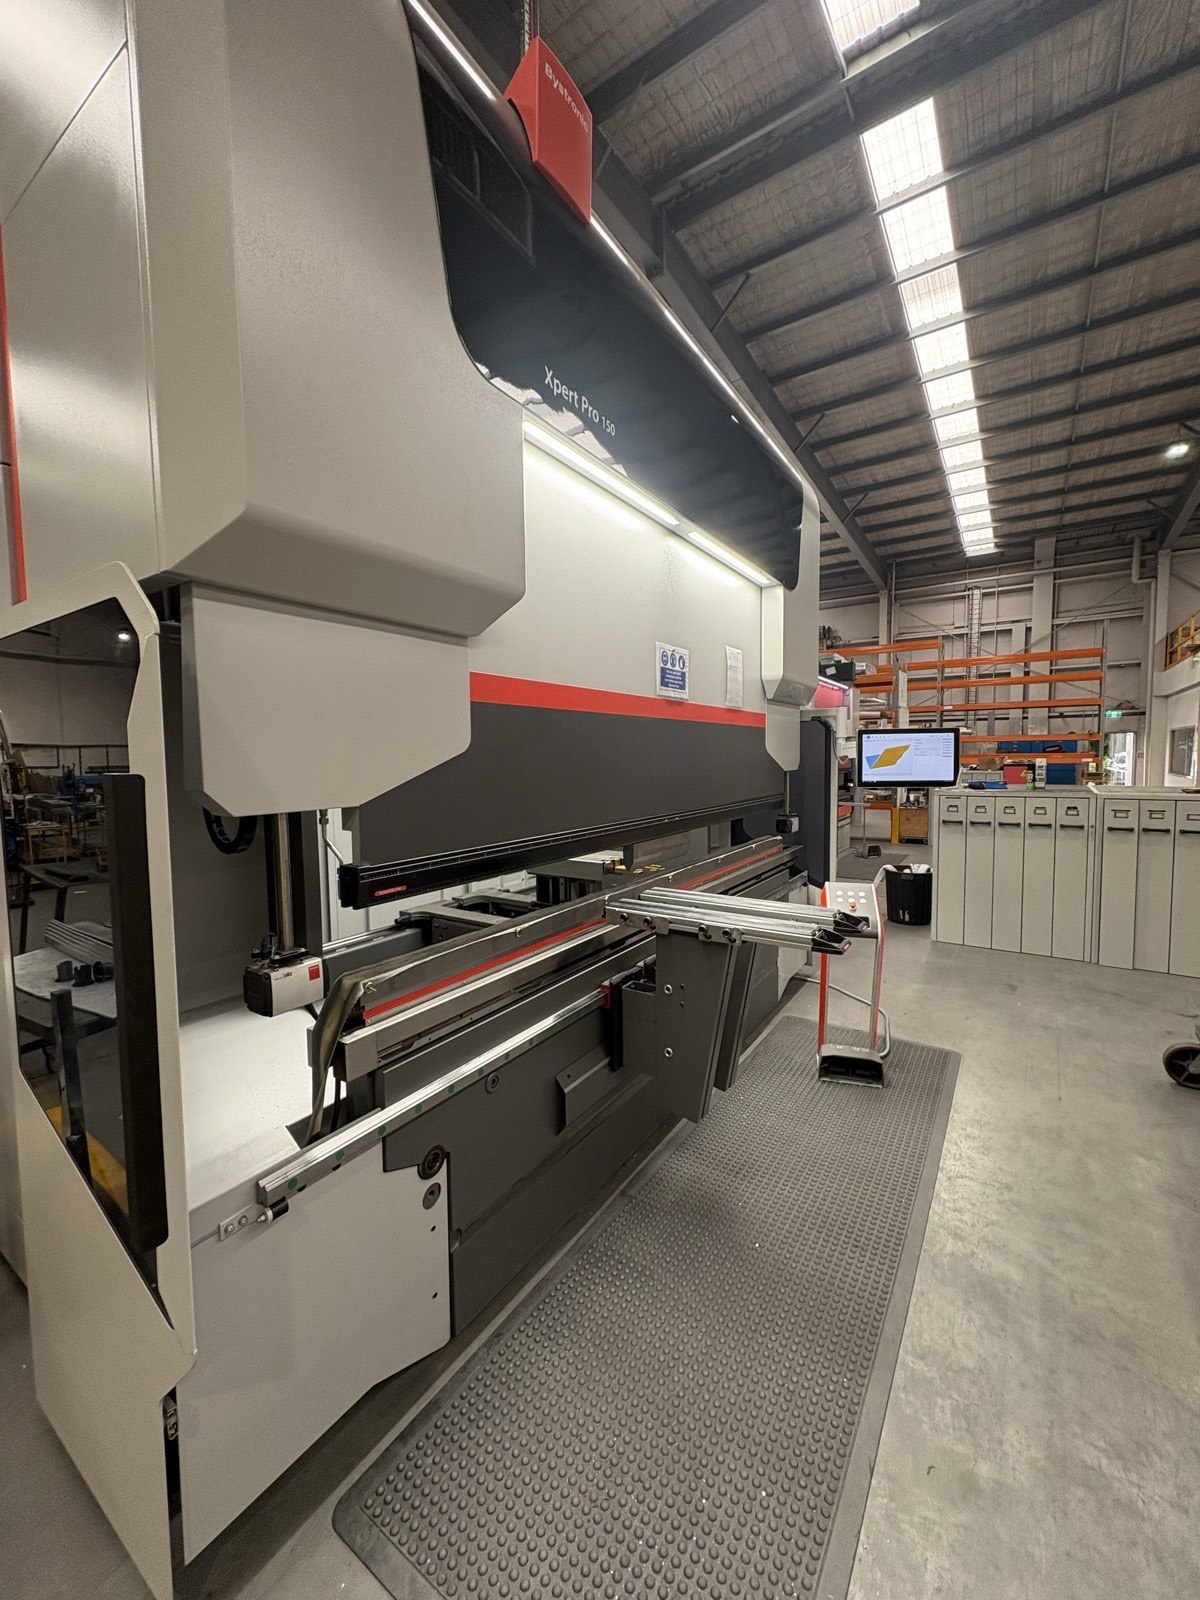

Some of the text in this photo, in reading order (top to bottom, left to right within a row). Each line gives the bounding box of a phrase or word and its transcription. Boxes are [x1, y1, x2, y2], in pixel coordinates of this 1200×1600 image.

[545, 62, 588, 132] Bystronic
[544, 365, 616, 436] Xpert Pro 150
